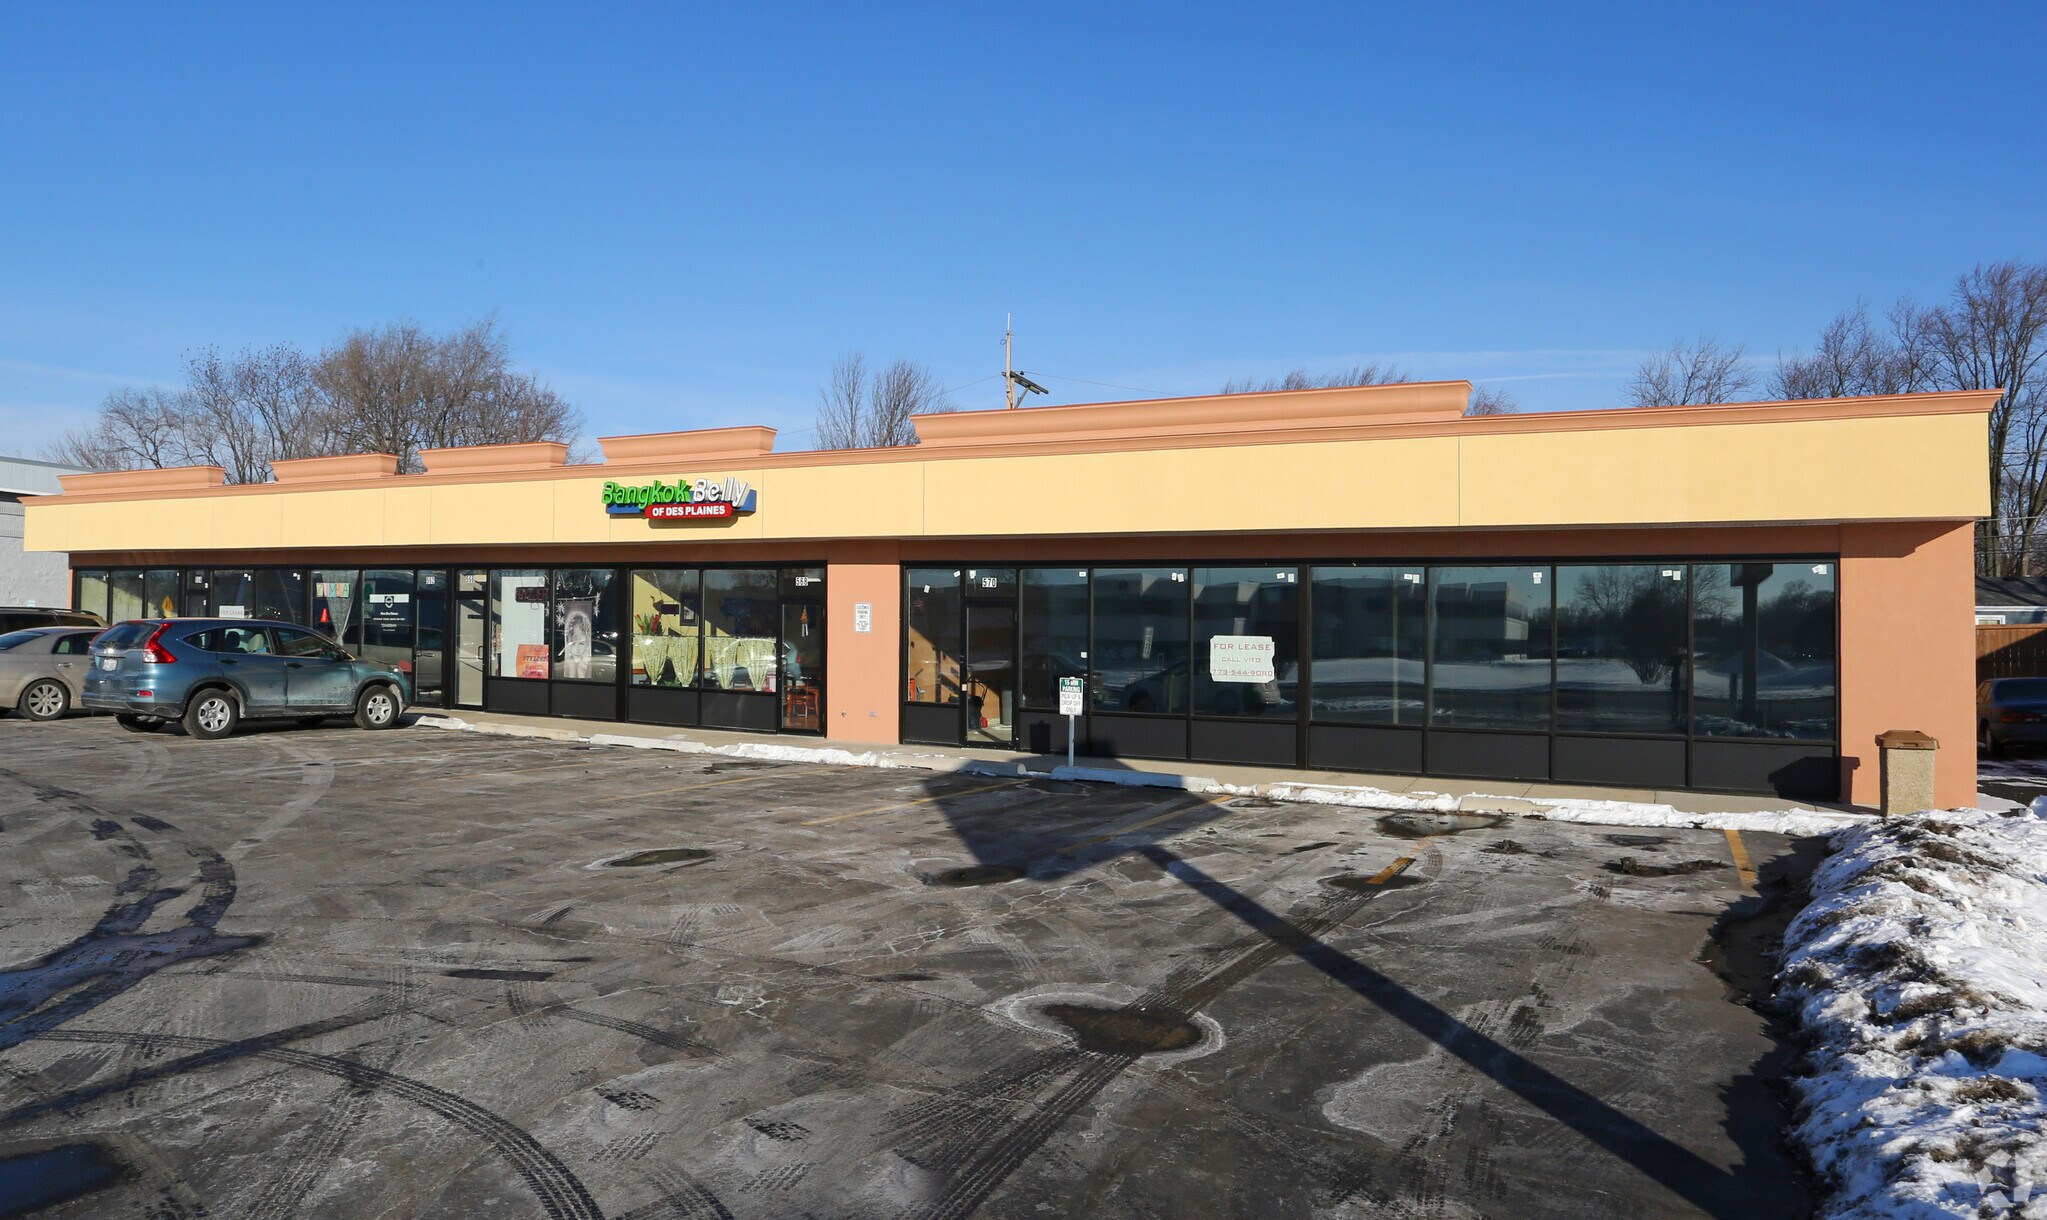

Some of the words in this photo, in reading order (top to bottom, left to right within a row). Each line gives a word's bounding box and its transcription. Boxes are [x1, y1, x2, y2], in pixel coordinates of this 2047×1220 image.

[602, 479, 692, 509] Bangkok
[693, 476, 750, 507] Belly
[652, 507, 664, 517] OF
[666, 507, 684, 516] DES
[685, 505, 726, 516] PLAINES
[796, 577, 808, 586] 568
[982, 578, 997, 588] 570
[1238, 643, 1271, 651] LEASE
